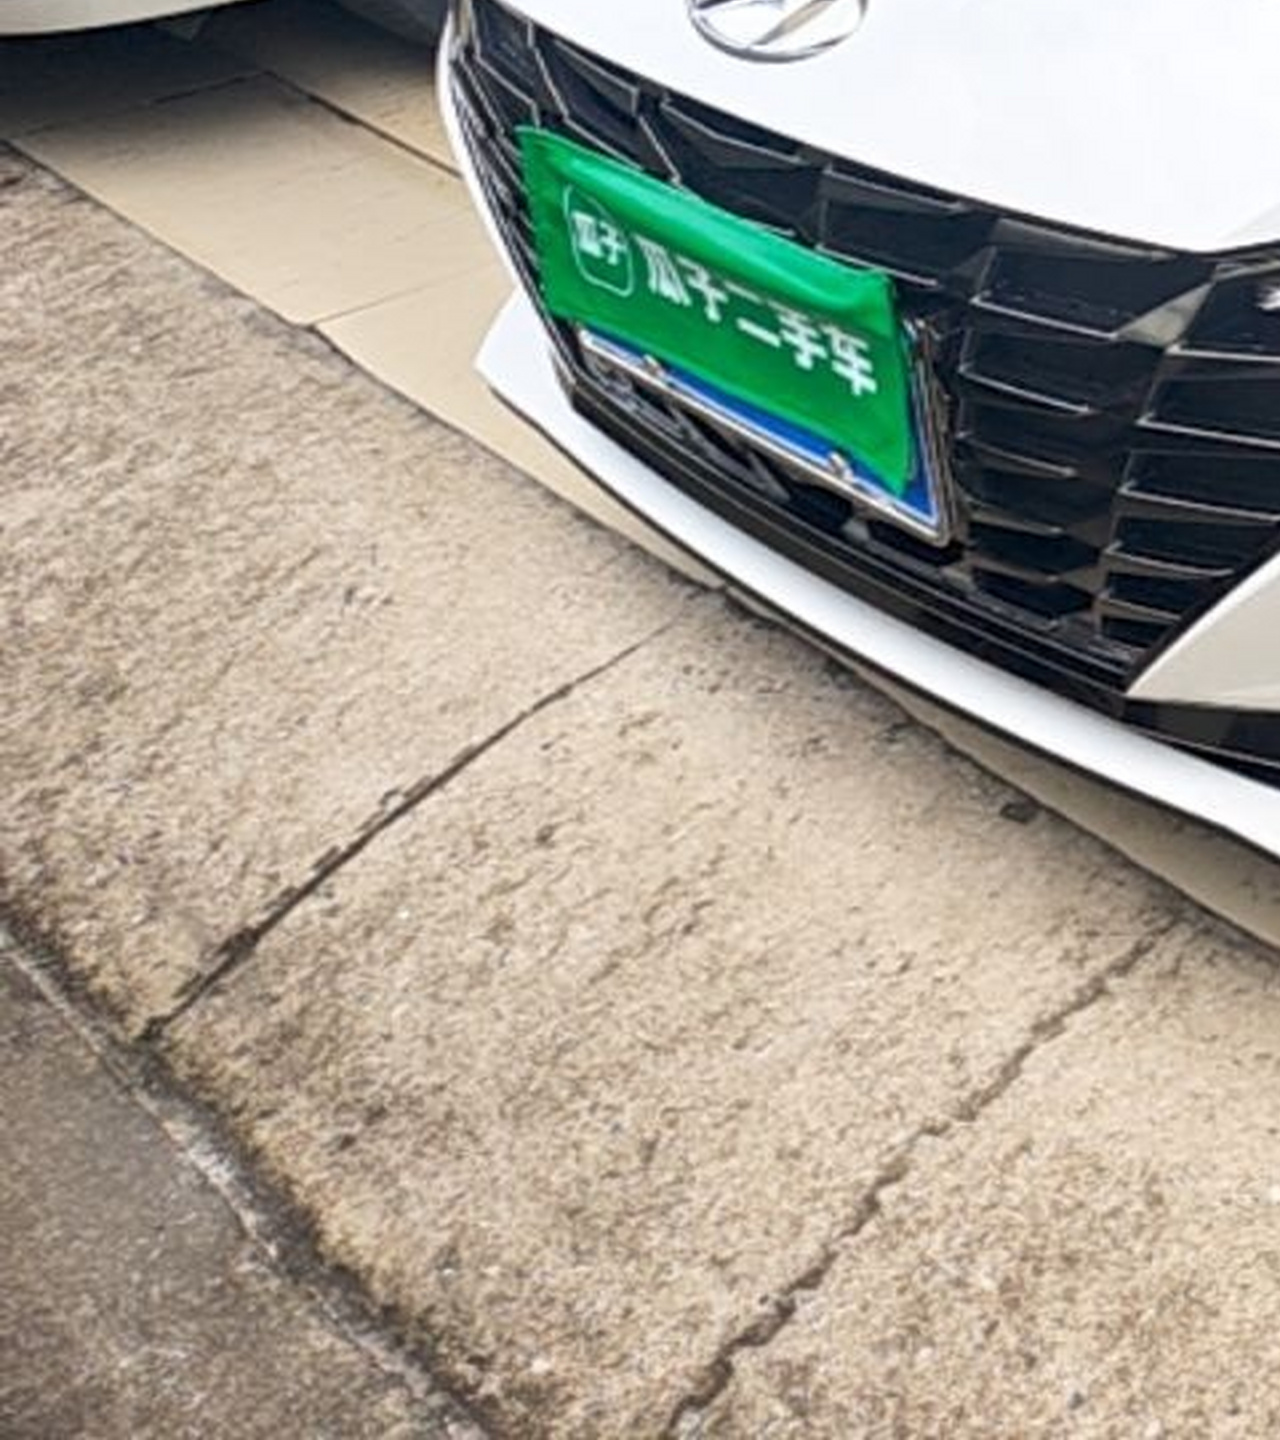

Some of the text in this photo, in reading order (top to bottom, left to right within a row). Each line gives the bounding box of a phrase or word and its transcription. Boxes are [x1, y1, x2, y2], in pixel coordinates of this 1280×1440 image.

[633, 233, 876, 396] 瓜子二手车
